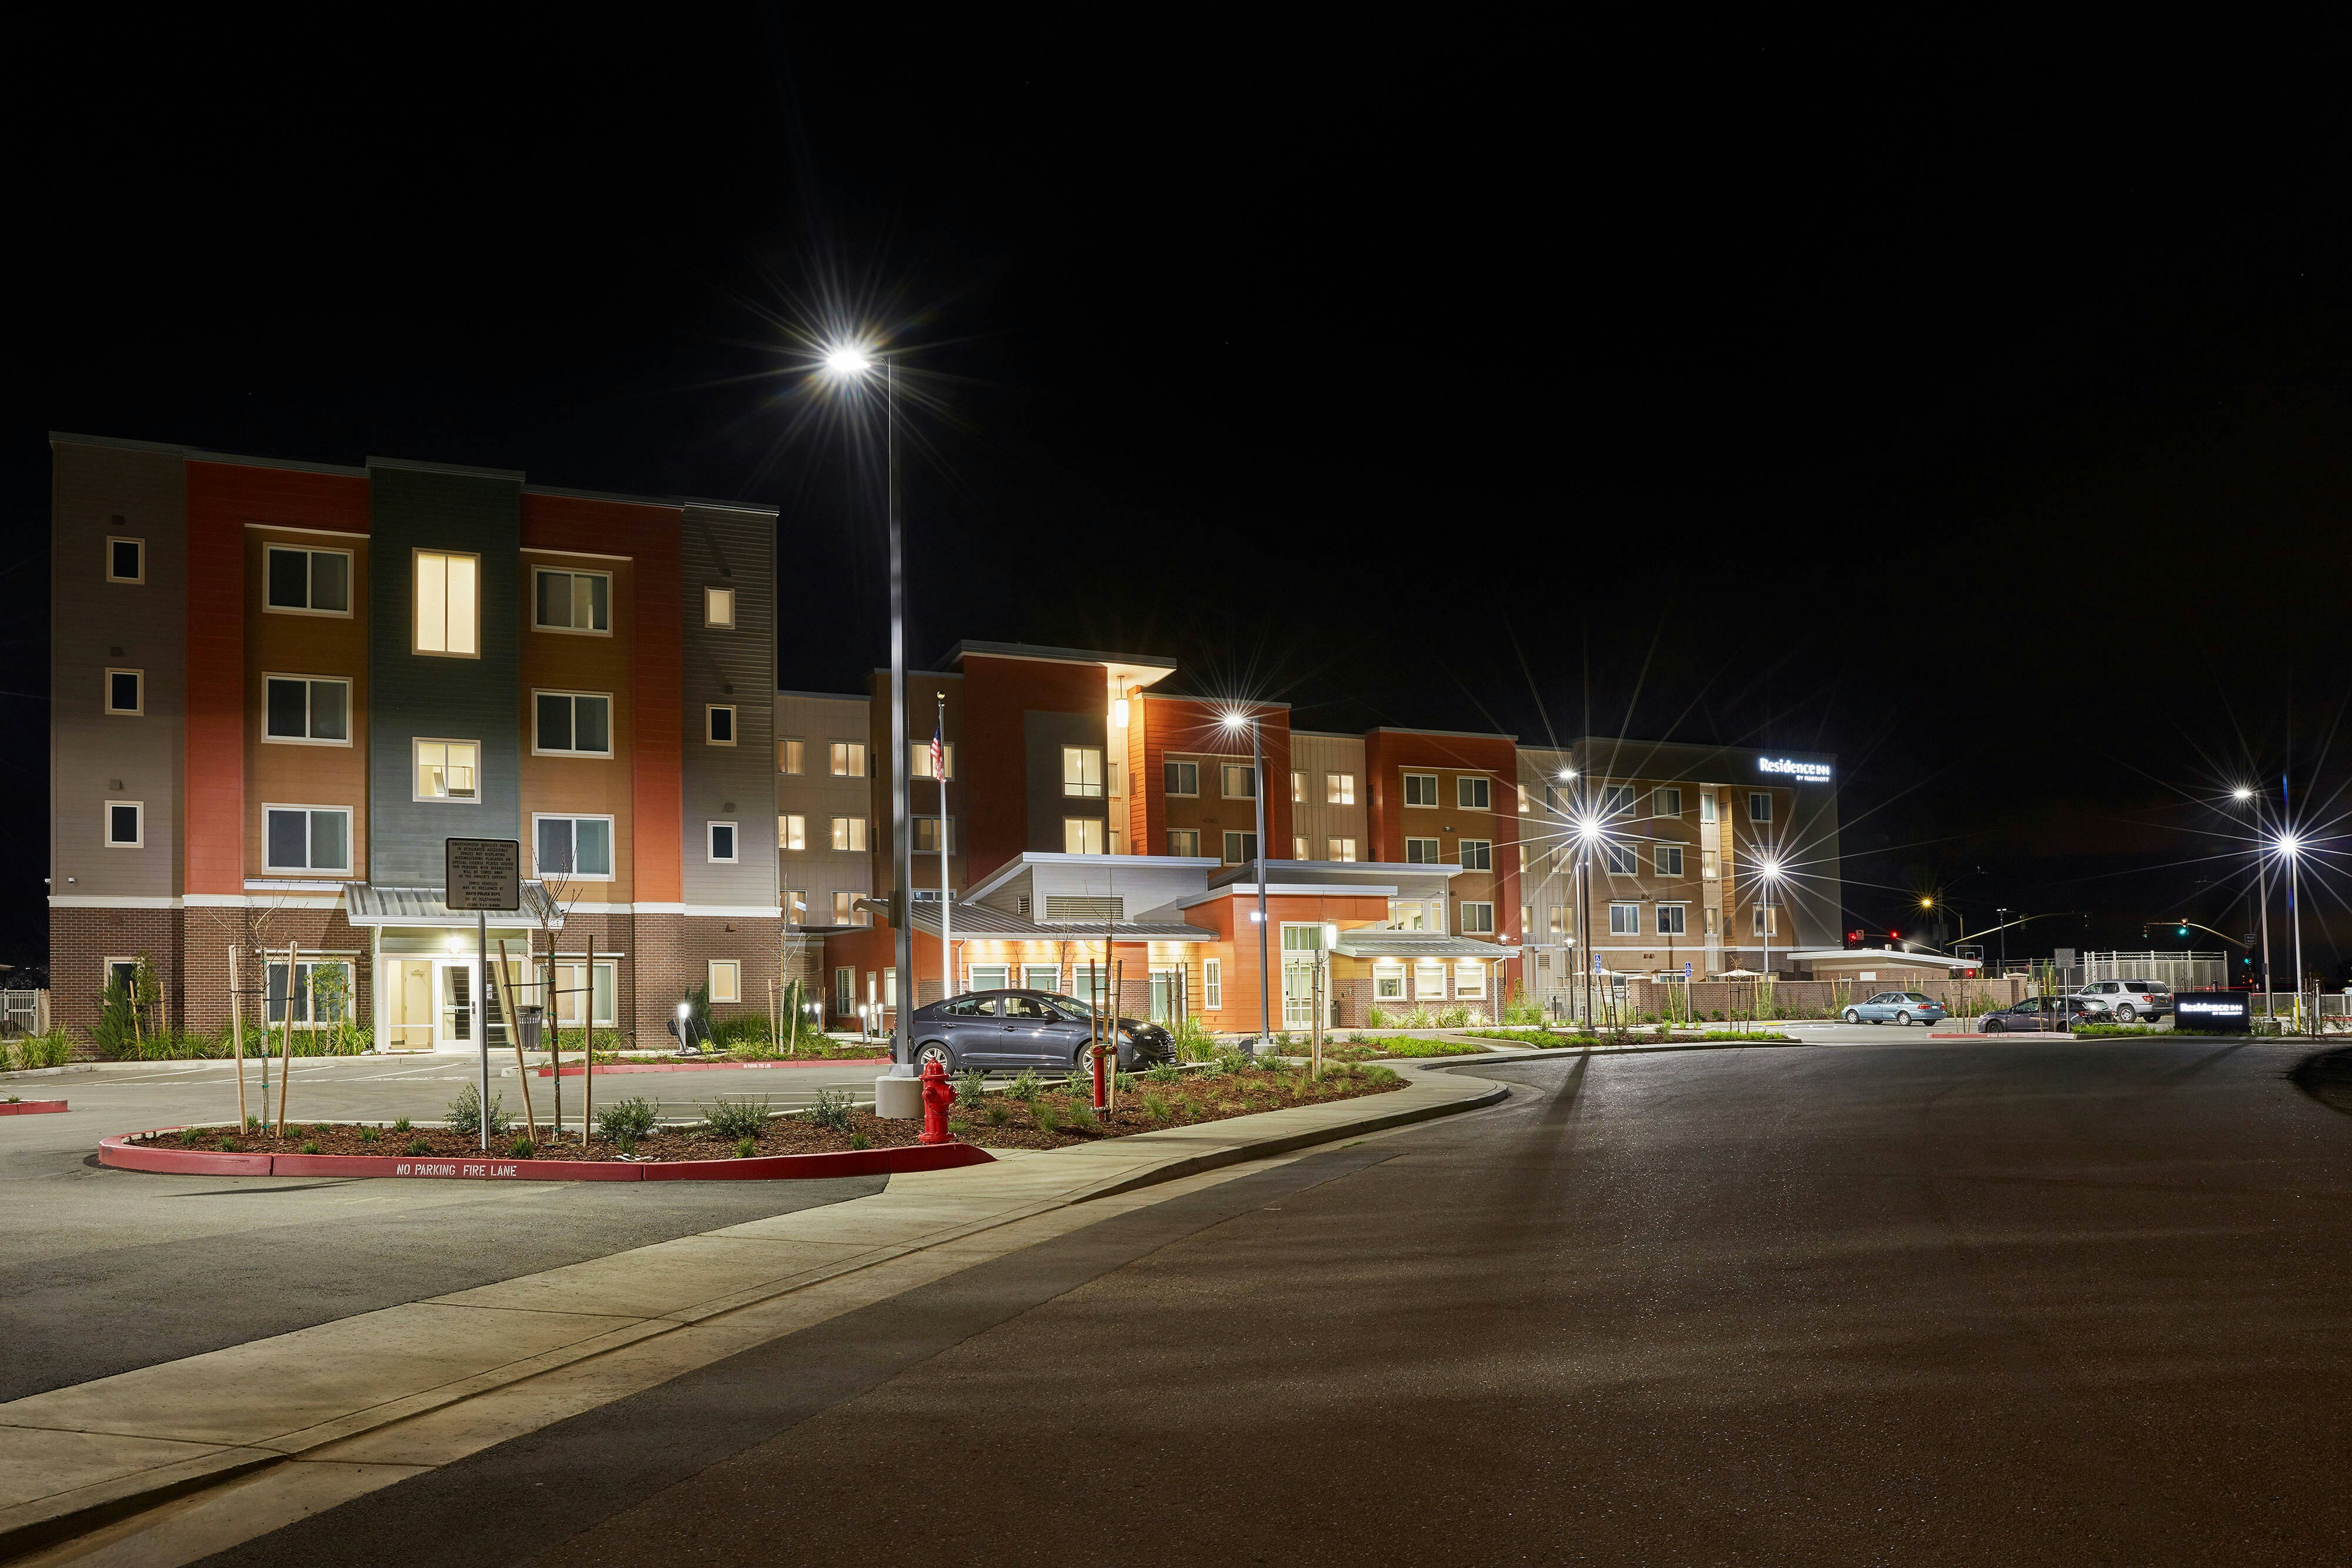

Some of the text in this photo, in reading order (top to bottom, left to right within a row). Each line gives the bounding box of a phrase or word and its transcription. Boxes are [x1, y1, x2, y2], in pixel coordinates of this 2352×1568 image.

[1759, 758, 1829, 775] Residence INN
[2180, 1003, 2229, 1011] Residence
[397, 1164, 517, 1176] NO PARKING FIRE LANE
